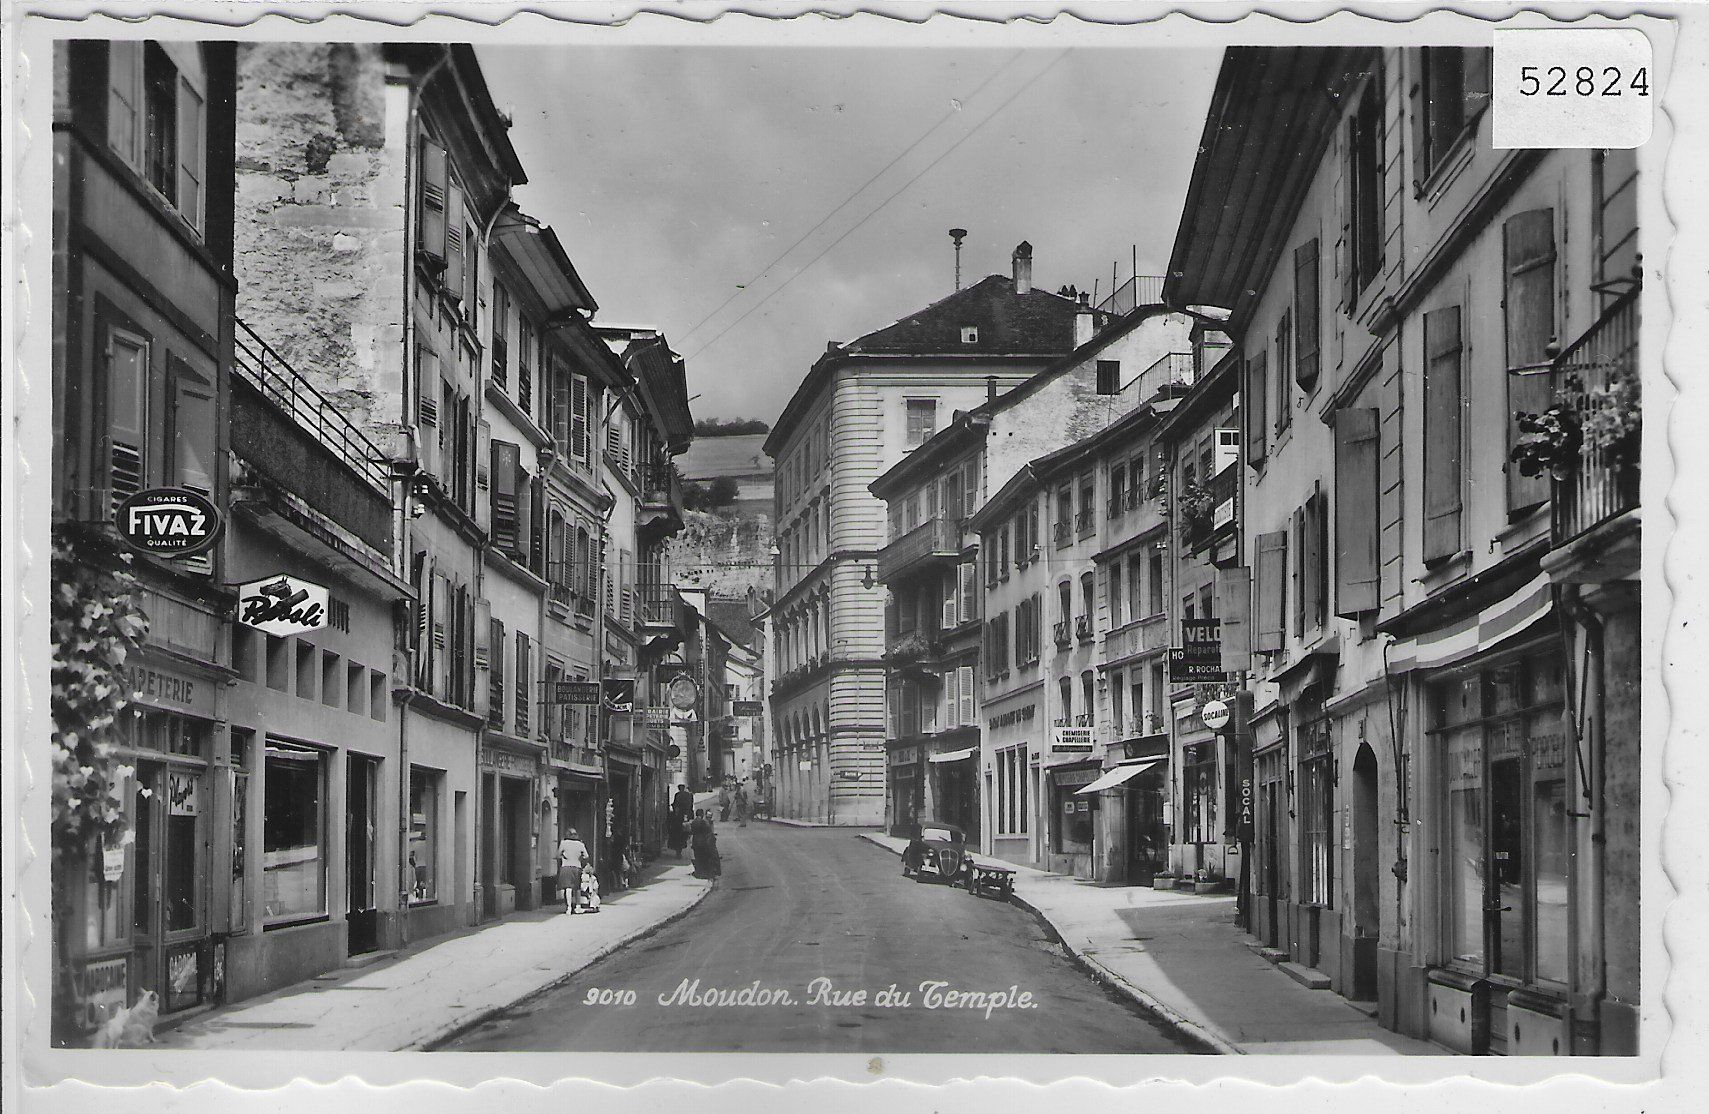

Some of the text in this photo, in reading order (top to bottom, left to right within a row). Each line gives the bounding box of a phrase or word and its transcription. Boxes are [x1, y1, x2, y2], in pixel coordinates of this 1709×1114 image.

[1519, 66, 1650, 96] 52824
[129, 503, 206, 536] FIVAZ
[147, 538, 187, 547] QUALITÉ
[127, 666, 194, 704] APETERIE
[557, 684, 598, 694] BOULANGERIE
[559, 693, 597, 702] PATISSERIE
[1242, 779, 1251, 824] SOCAL
